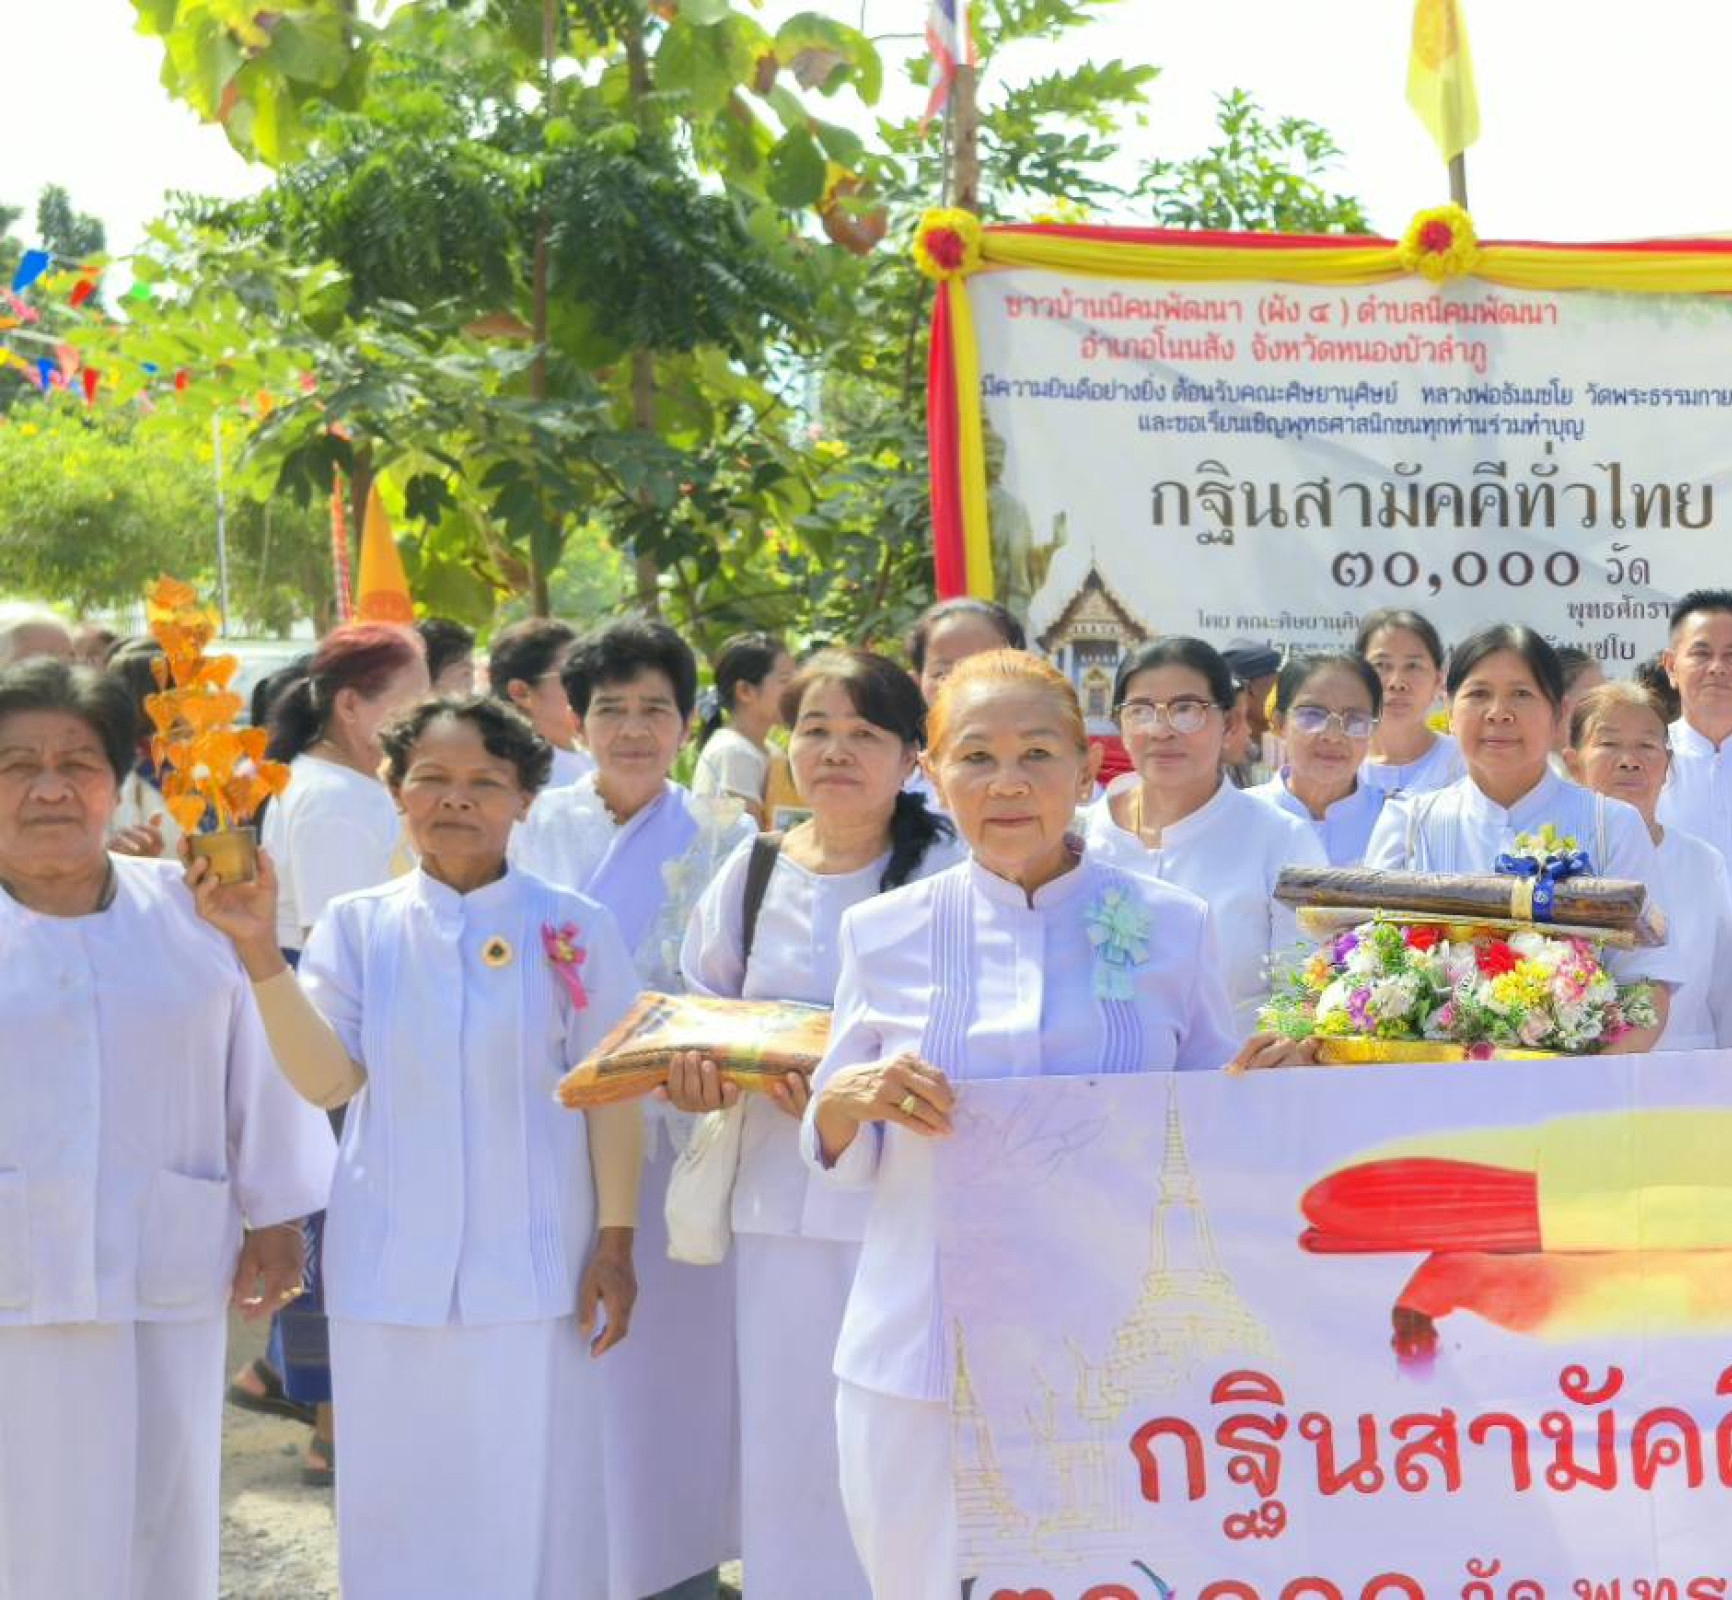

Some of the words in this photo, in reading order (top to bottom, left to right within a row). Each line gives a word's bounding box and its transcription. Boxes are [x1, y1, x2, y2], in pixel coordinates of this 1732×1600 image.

[1356, 293, 1560, 325] ตำบลนิคมพัฒนา
[1080, 324, 1236, 361] อำเภอโนนสัง
[1251, 331, 1488, 373] จังหวัดหนองบัวลำภู
[1149, 441, 1716, 546] กฐินสามัคคีทั่วไทย
[1330, 548, 1582, 596] ๓๐,๐๐๐
[1604, 541, 1652, 587] วัด
[1566, 593, 1672, 629] พุทธศักรา
